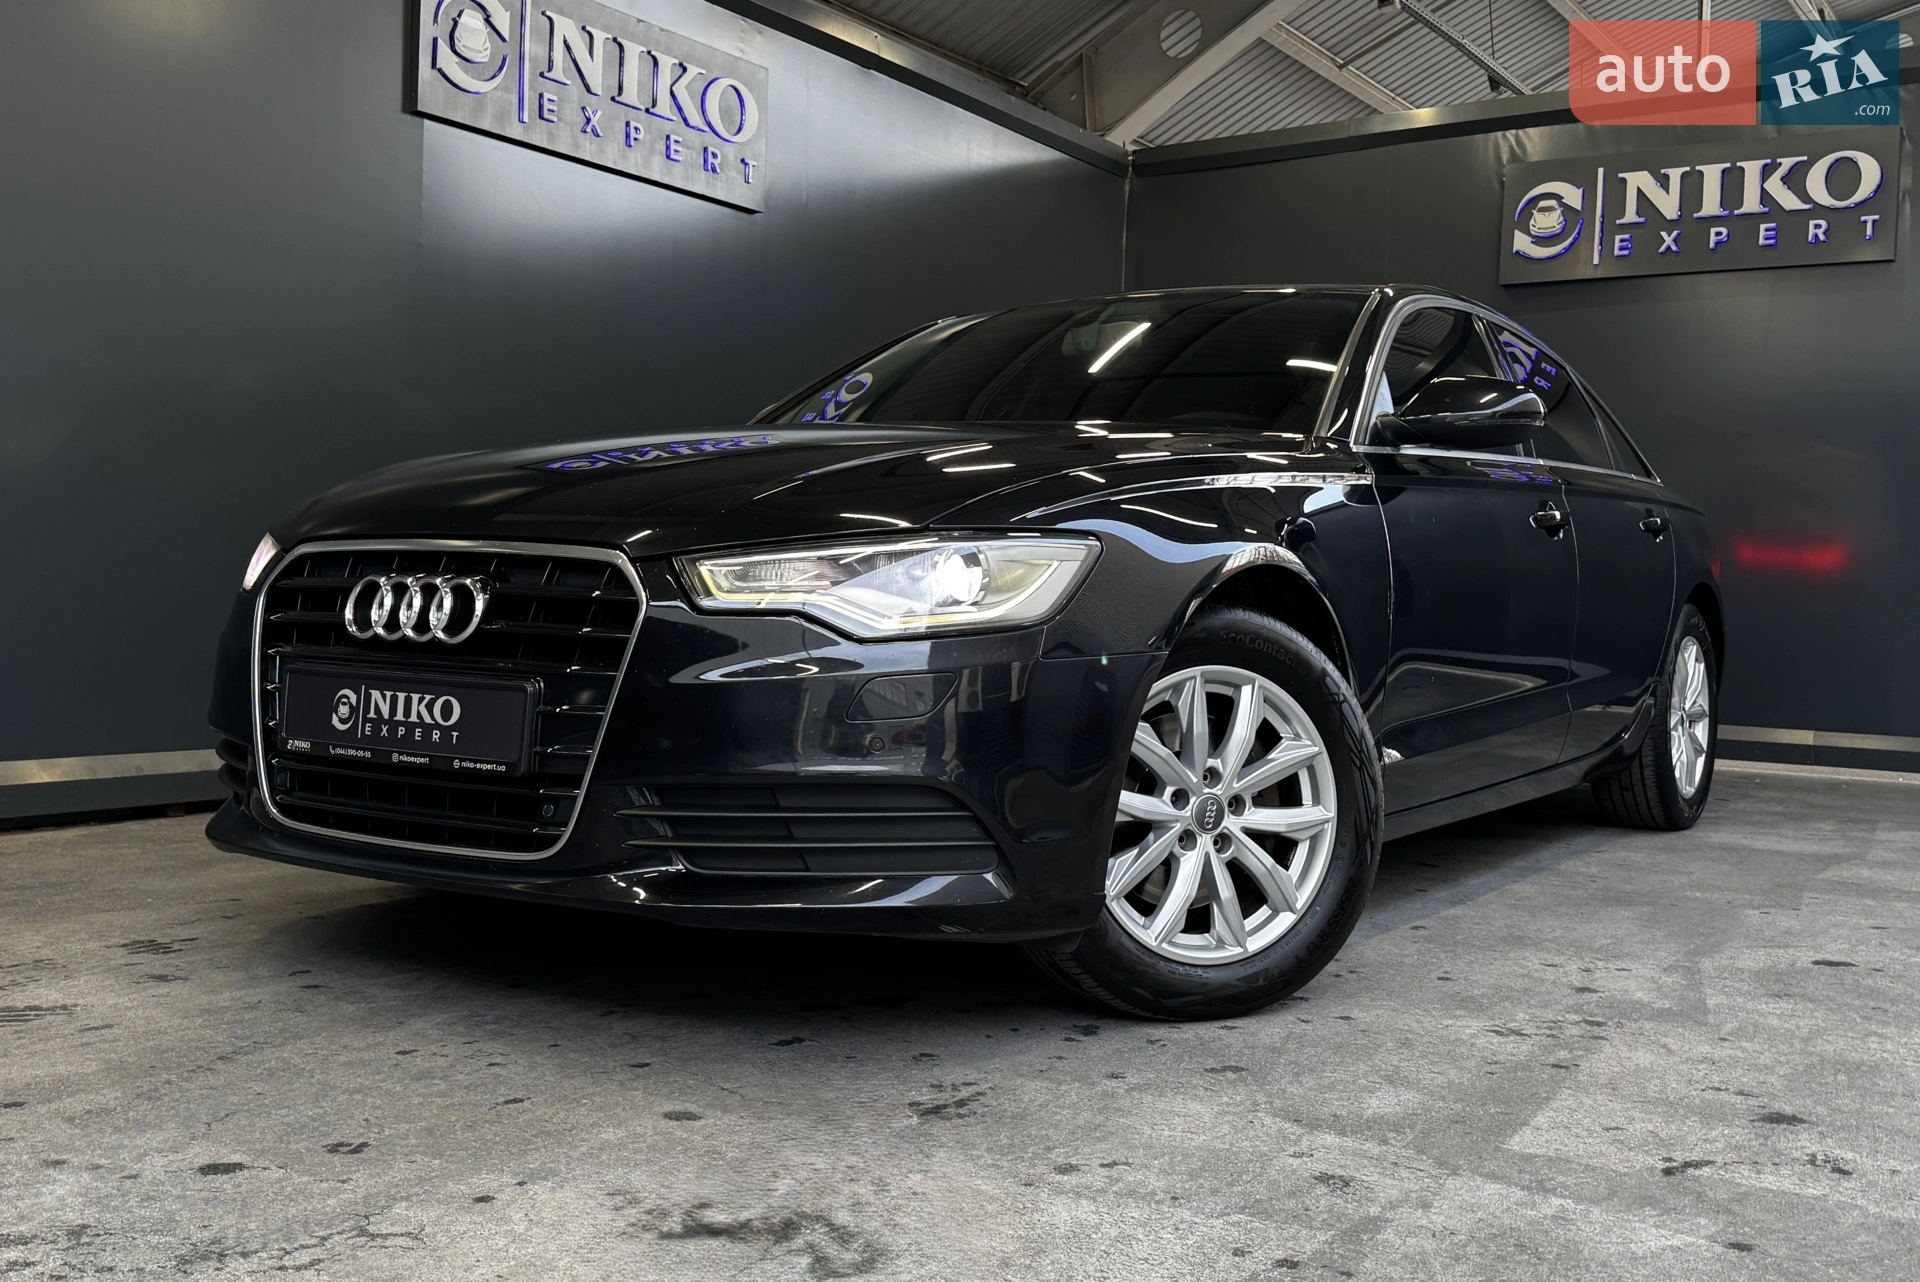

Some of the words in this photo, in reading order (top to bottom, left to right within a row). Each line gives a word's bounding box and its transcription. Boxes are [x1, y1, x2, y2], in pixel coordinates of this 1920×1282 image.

[539, 10, 758, 143] NIKO
[538, 91, 757, 184] EXPERT
[1616, 149, 1884, 226] NIKO
[1613, 214, 1882, 258] EXPERT
[367, 689, 462, 727] NIKO
[294, 739, 311, 749] NIKO
[364, 722, 460, 745] EXPERT
[399, 754, 430, 764] nikoexpert
[461, 760, 507, 772] niko-expert.ua
